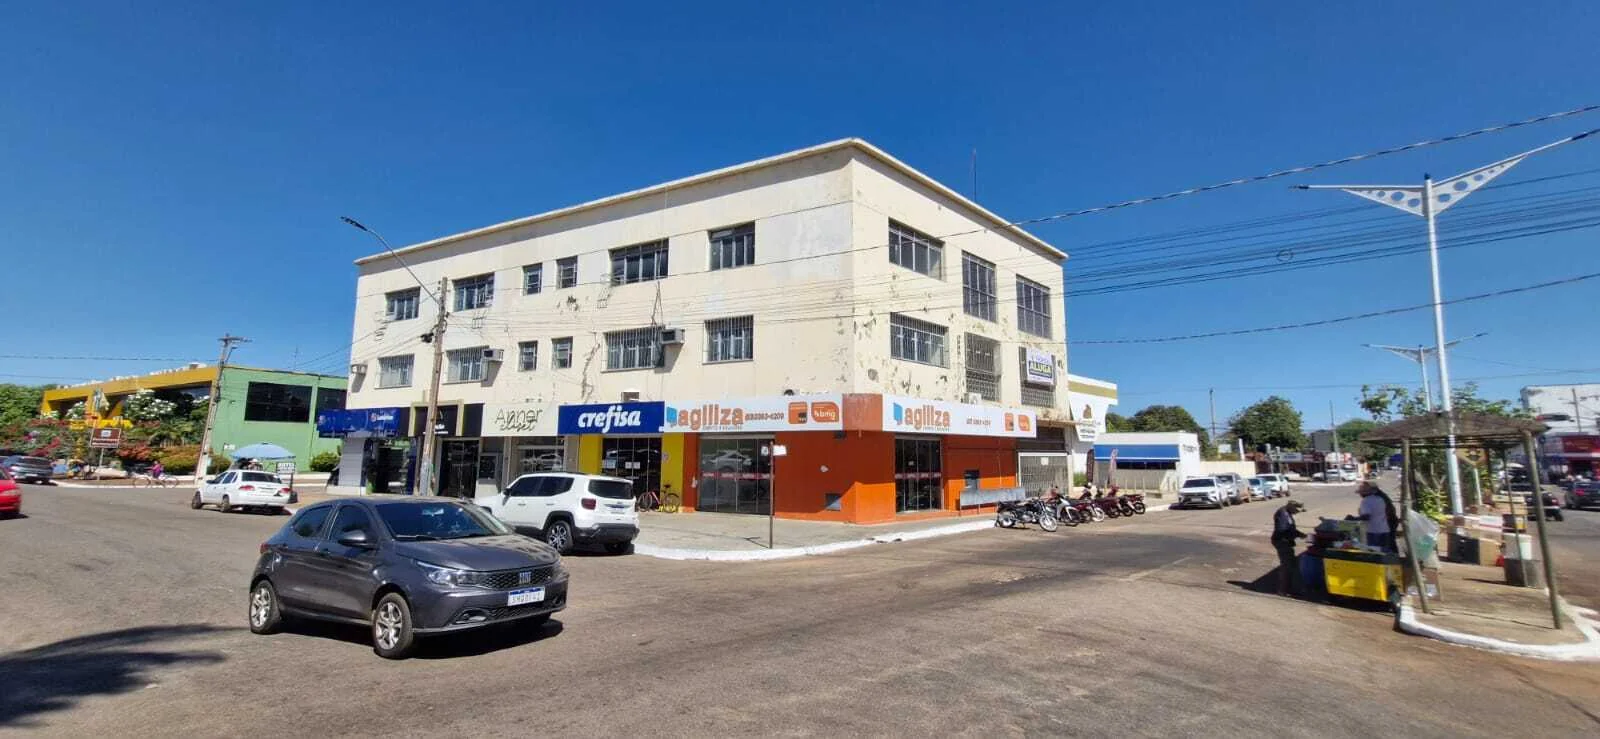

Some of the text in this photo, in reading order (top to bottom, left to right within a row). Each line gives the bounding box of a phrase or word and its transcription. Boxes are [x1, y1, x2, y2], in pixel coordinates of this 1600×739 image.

[1029, 361, 1051, 373] ALUGA
[577, 405, 641, 434] crefisa
[678, 404, 744, 430] agiliza
[905, 405, 950, 430] agiliza
